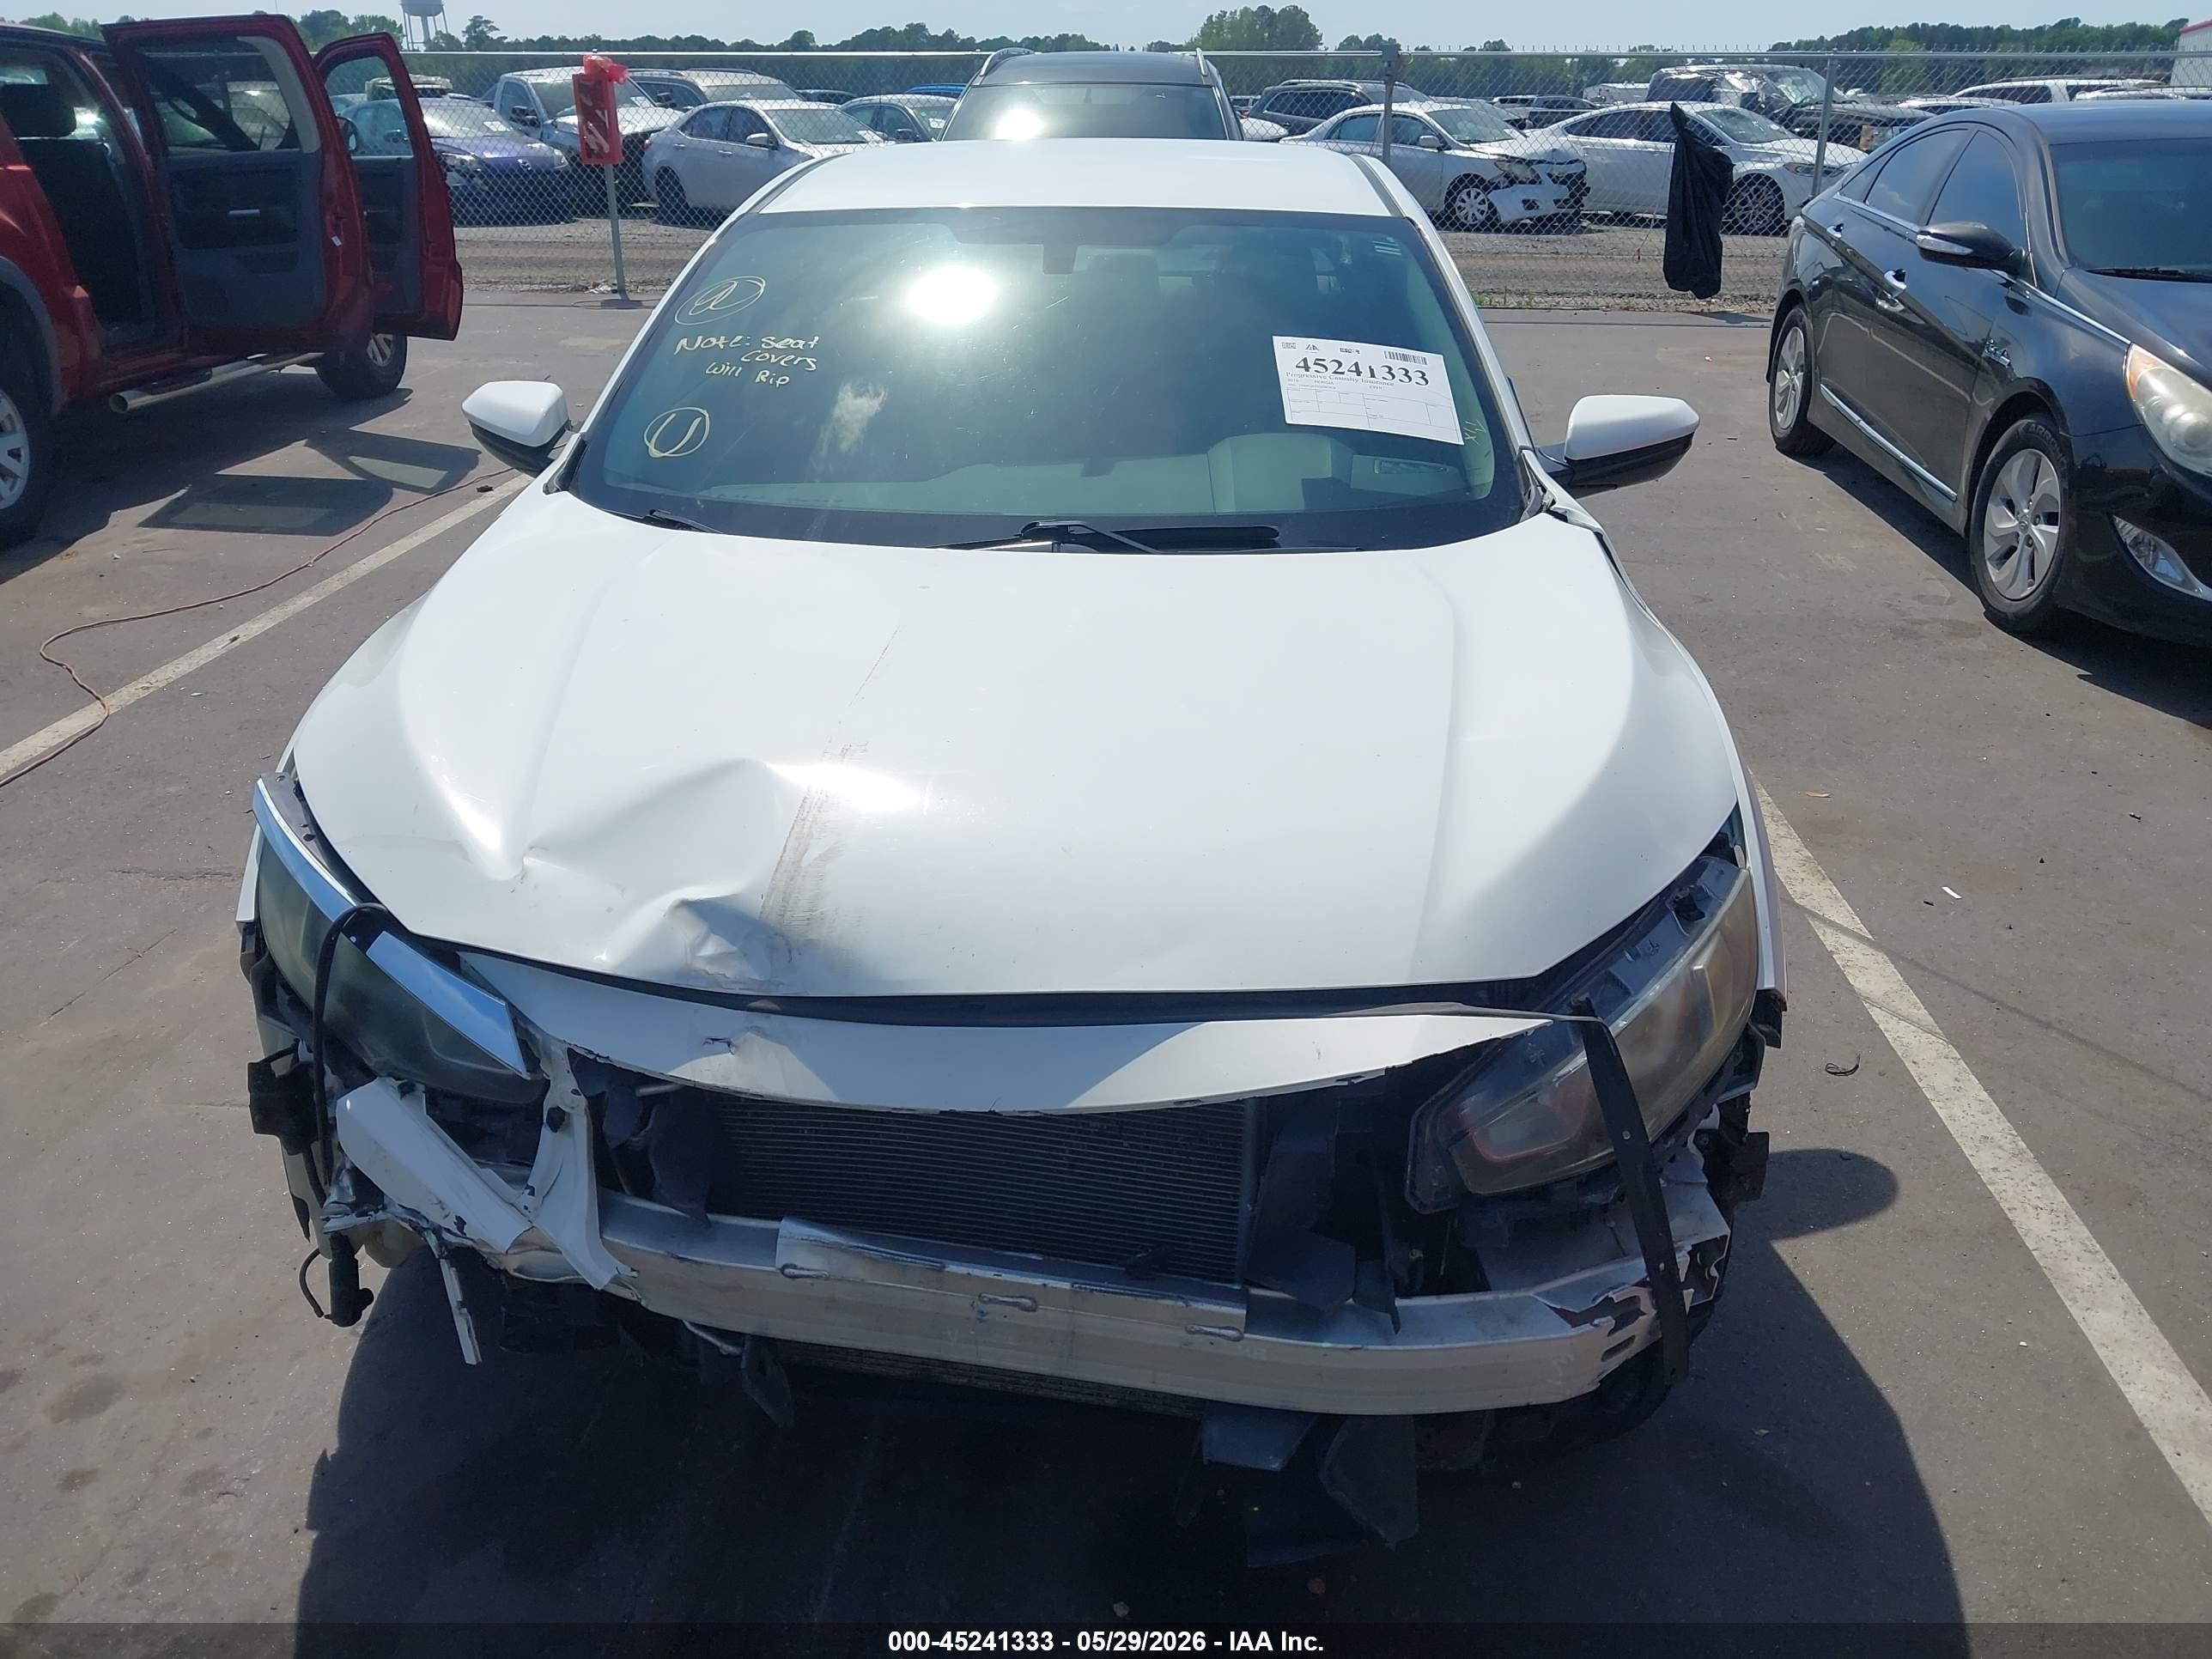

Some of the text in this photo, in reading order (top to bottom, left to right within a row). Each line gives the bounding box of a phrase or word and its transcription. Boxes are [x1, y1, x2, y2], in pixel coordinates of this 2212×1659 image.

[674, 336, 751, 356] Note:
[755, 370, 790, 387] Rip
[1295, 356, 1429, 386] 45241333
[1329, 375, 1359, 384] Casualty
[1361, 378, 1395, 386] Insurance
